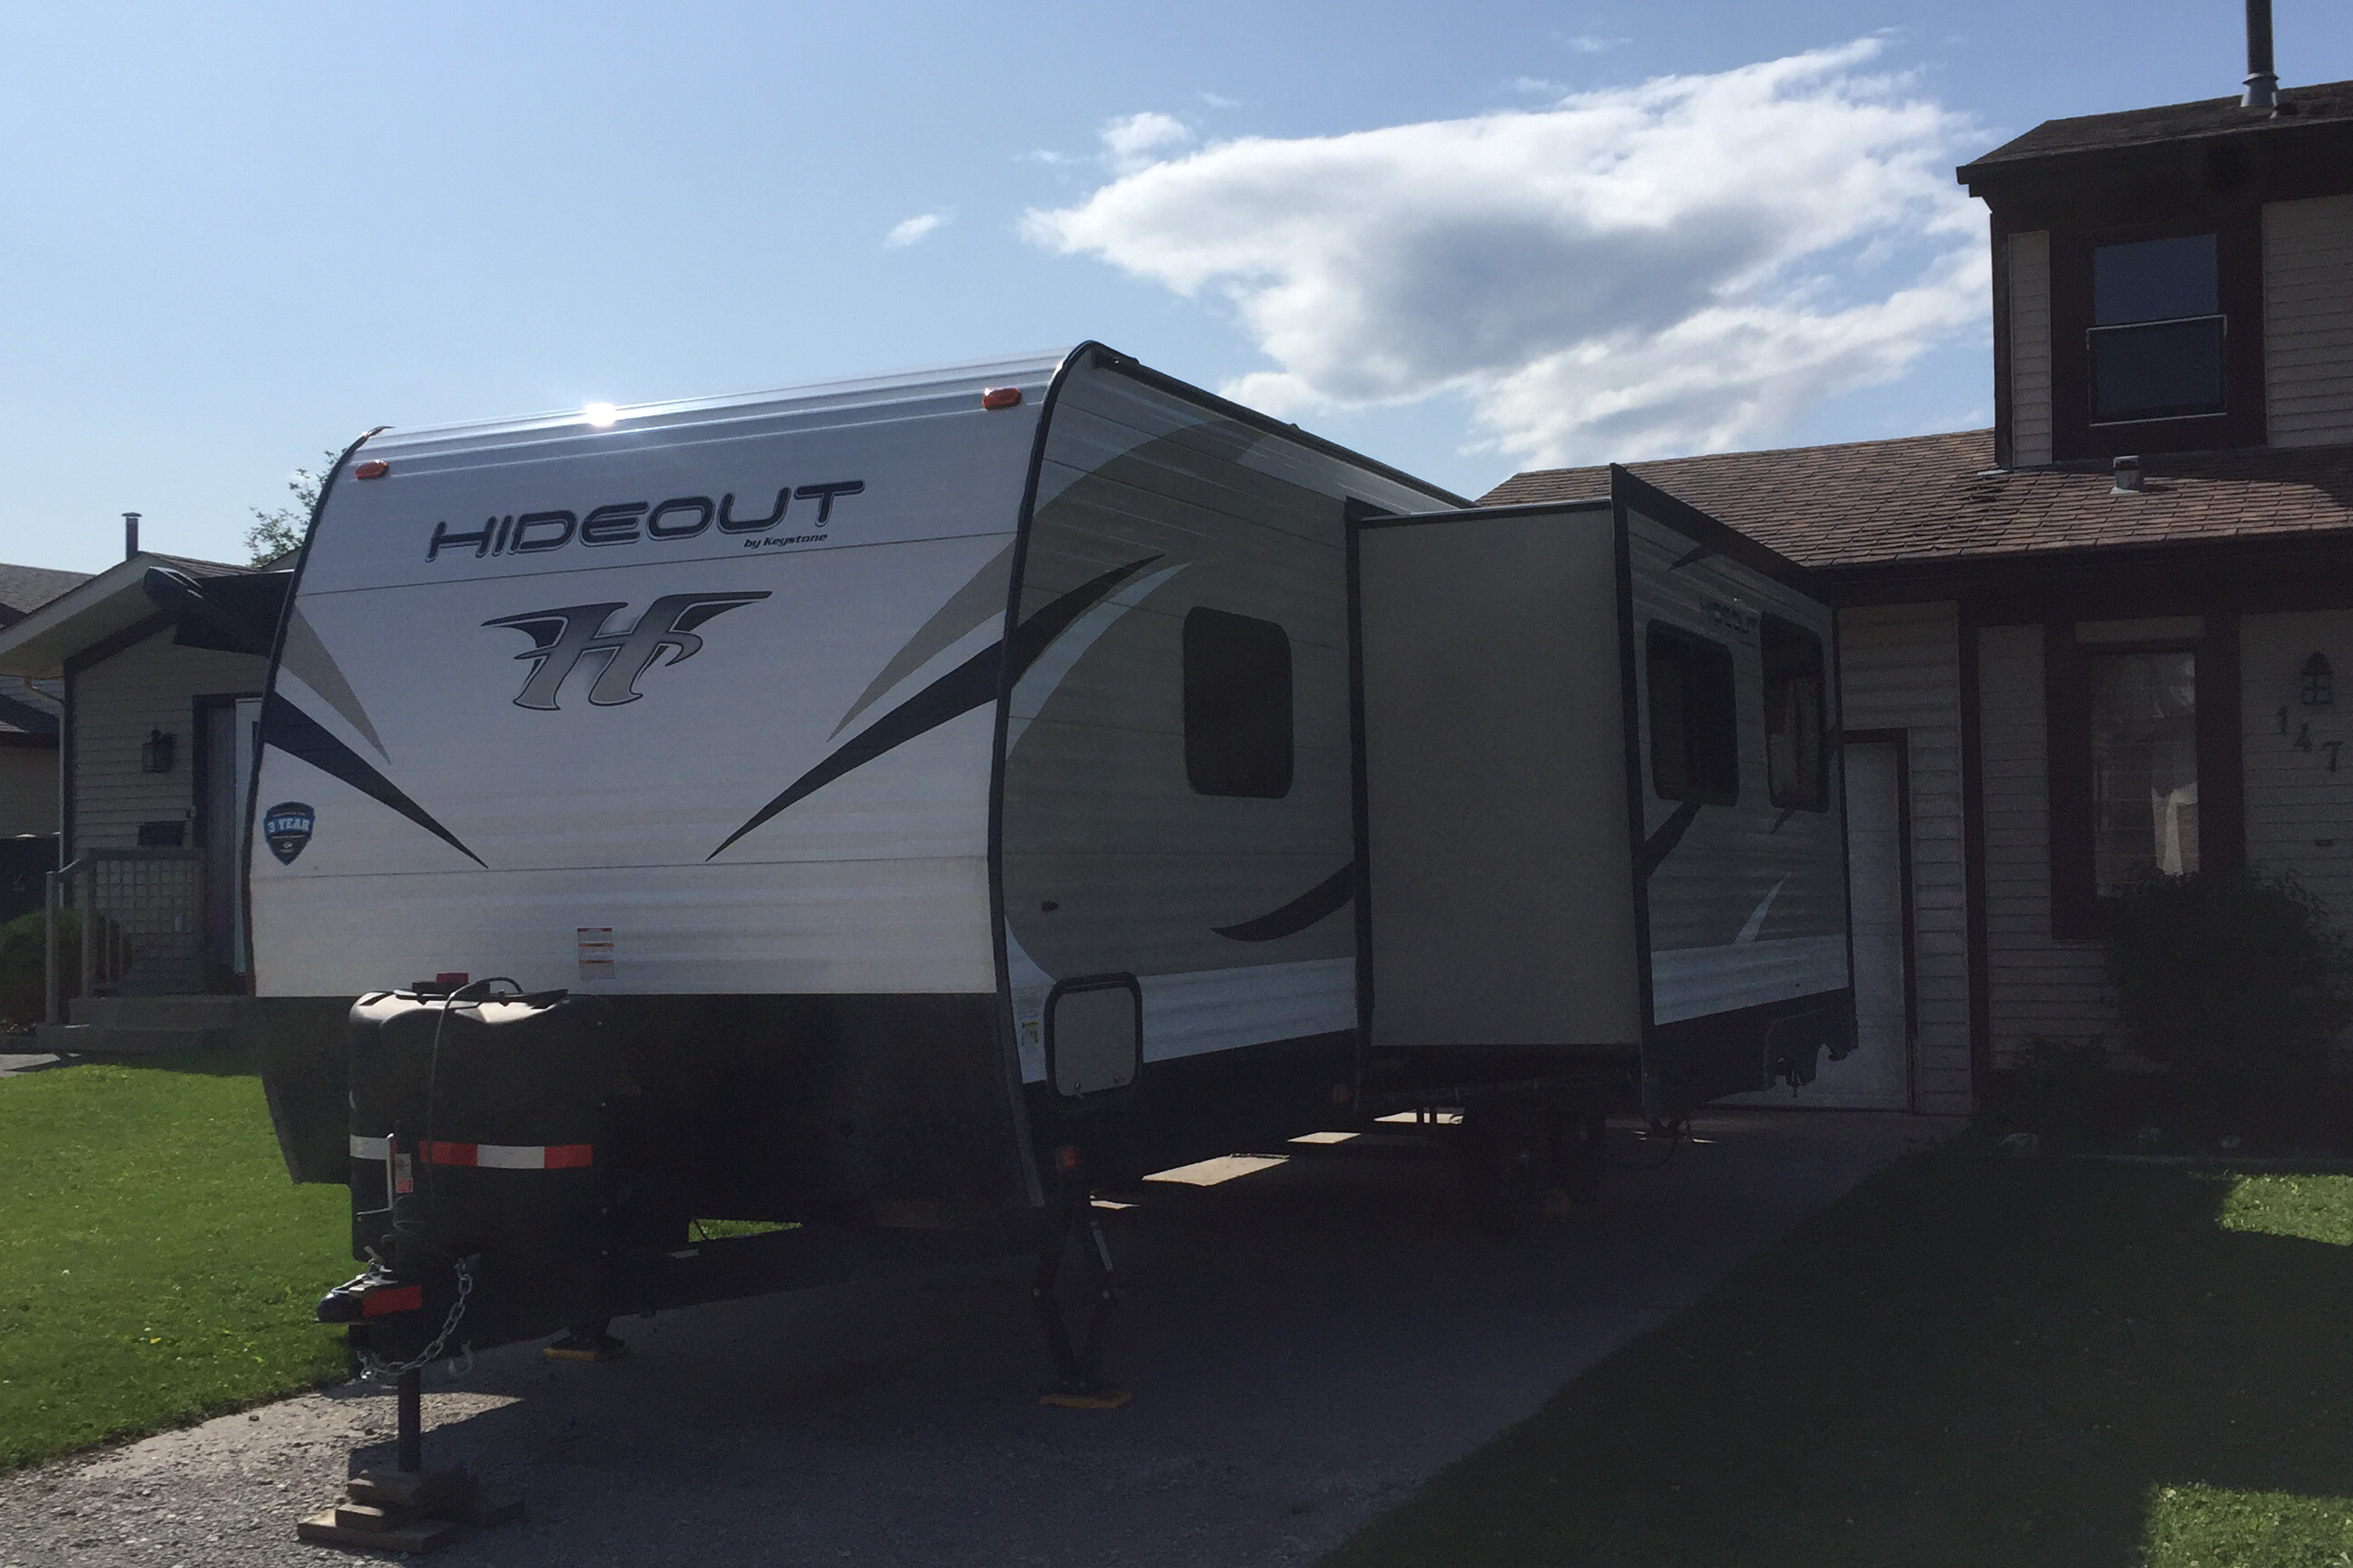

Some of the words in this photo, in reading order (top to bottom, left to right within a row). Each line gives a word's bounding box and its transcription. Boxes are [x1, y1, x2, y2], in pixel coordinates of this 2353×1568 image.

[425, 479, 866, 562] HIDEOUT
[743, 539, 762, 549] by
[763, 533, 828, 547] Keystone
[278, 817, 310, 831] YEAR
